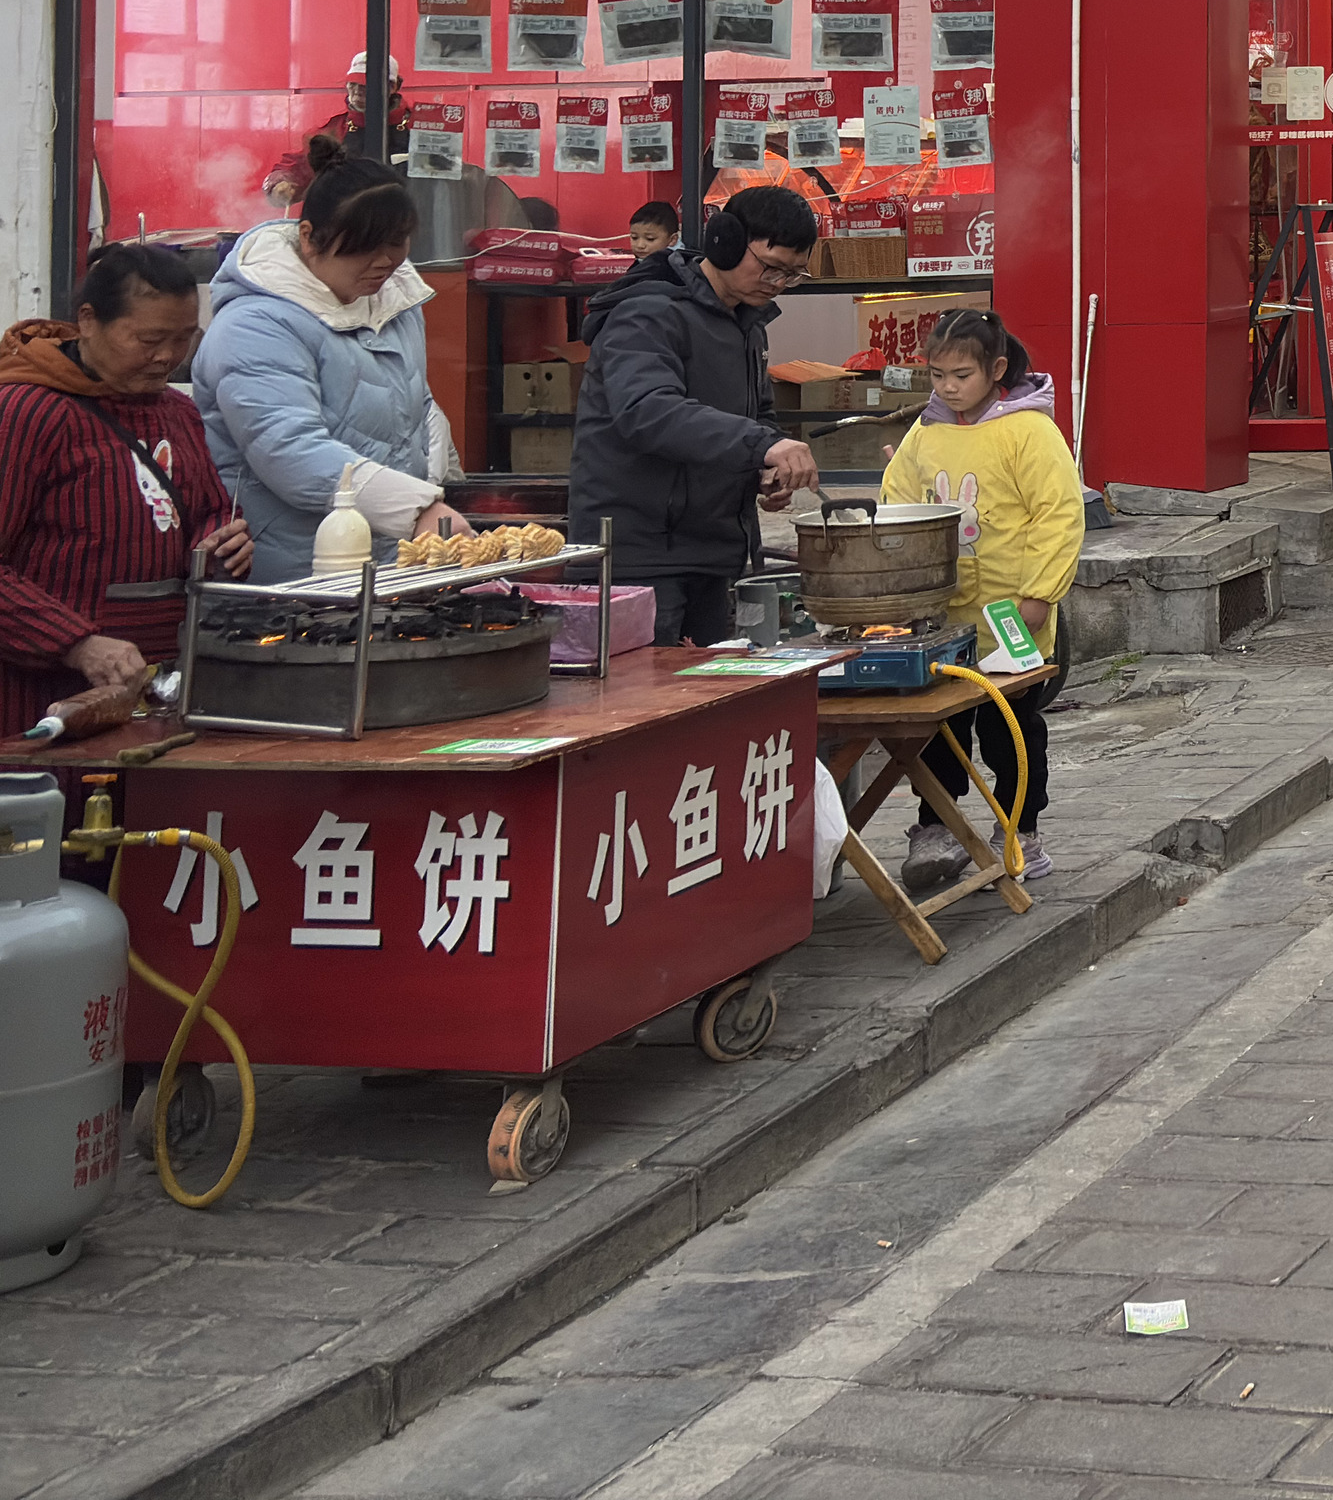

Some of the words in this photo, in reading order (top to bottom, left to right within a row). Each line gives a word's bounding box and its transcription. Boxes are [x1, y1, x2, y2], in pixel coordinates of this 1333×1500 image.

[163, 810, 511, 954] 小鱼饼
[587, 729, 796, 927] 小鱼饼
